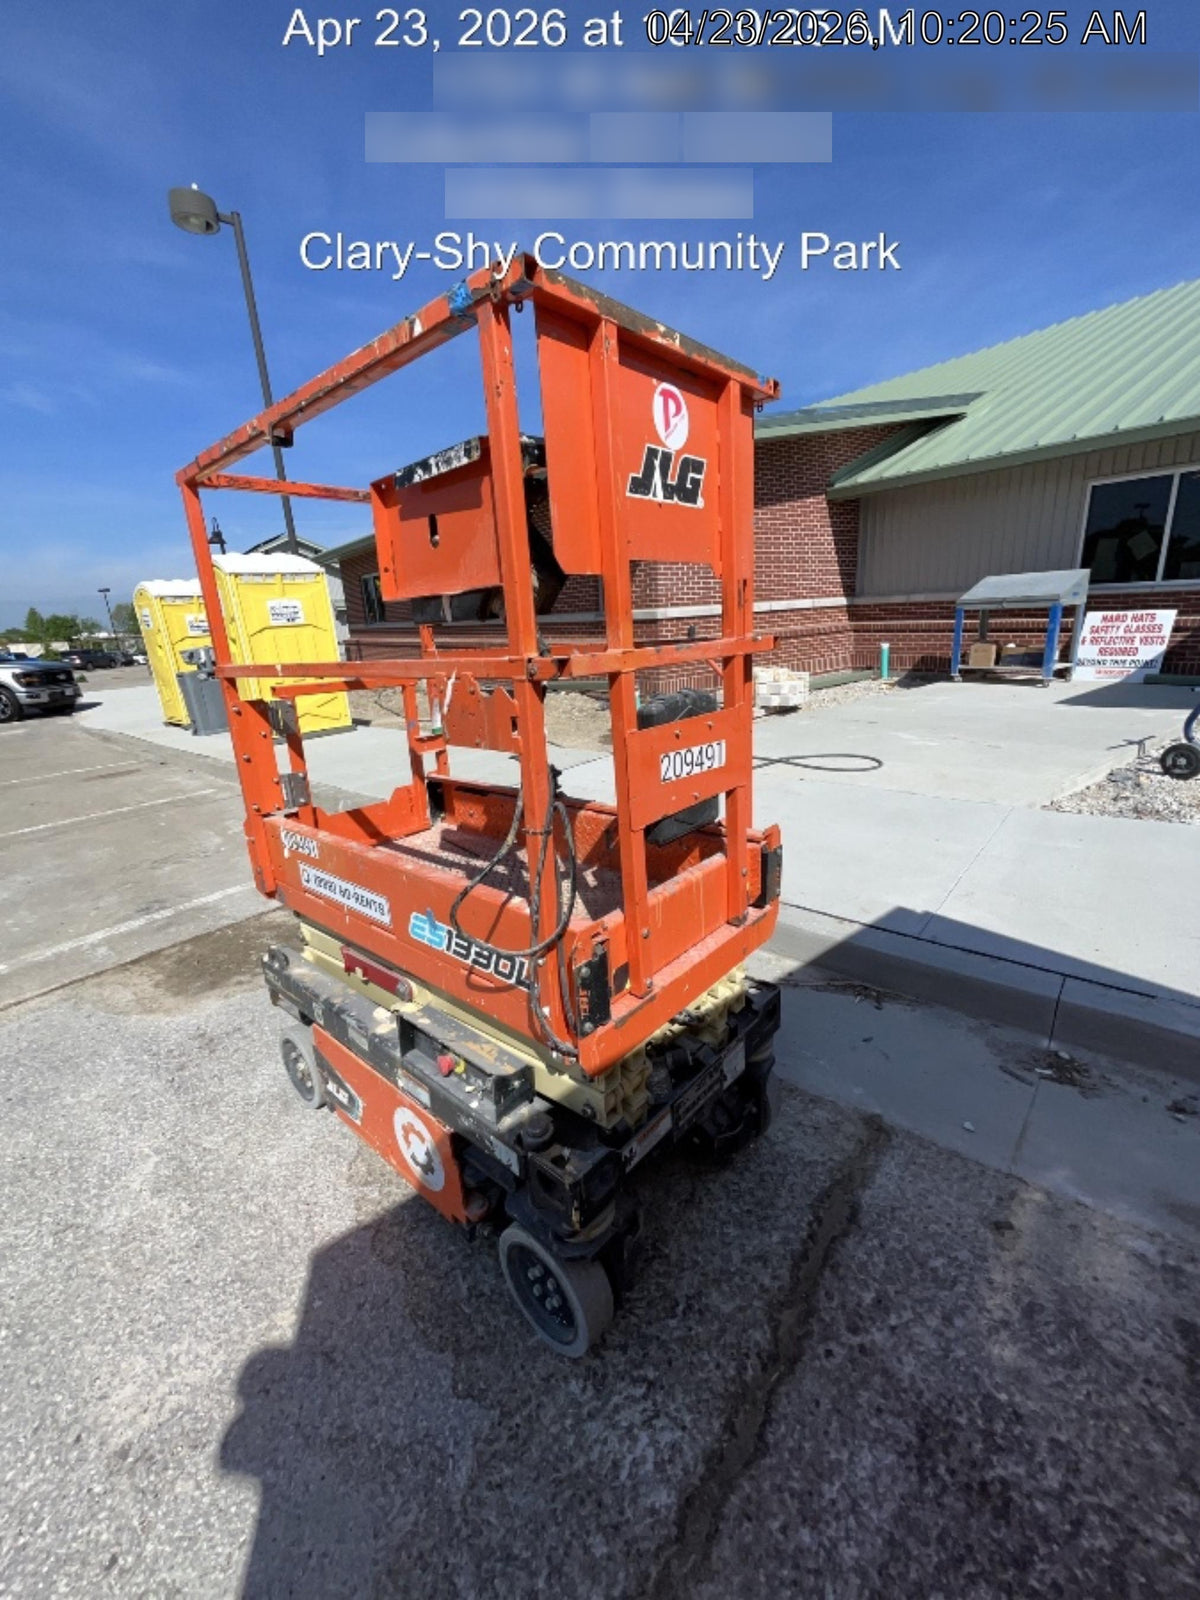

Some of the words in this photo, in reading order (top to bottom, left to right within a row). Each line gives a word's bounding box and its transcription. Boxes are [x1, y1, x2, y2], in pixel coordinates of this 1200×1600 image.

[627, 444, 706, 508] JLG
[1100, 613, 1128, 624] HARD
[1130, 612, 1157, 623] HATS
[1089, 625, 1120, 635] SAFETY
[1123, 624, 1164, 634] GLASSES
[1089, 636, 1137, 646] REFLECTIVE
[1140, 635, 1166, 646] VESTS
[1097, 646, 1139, 657] REQUIRED
[661, 742, 723, 782] 209491
